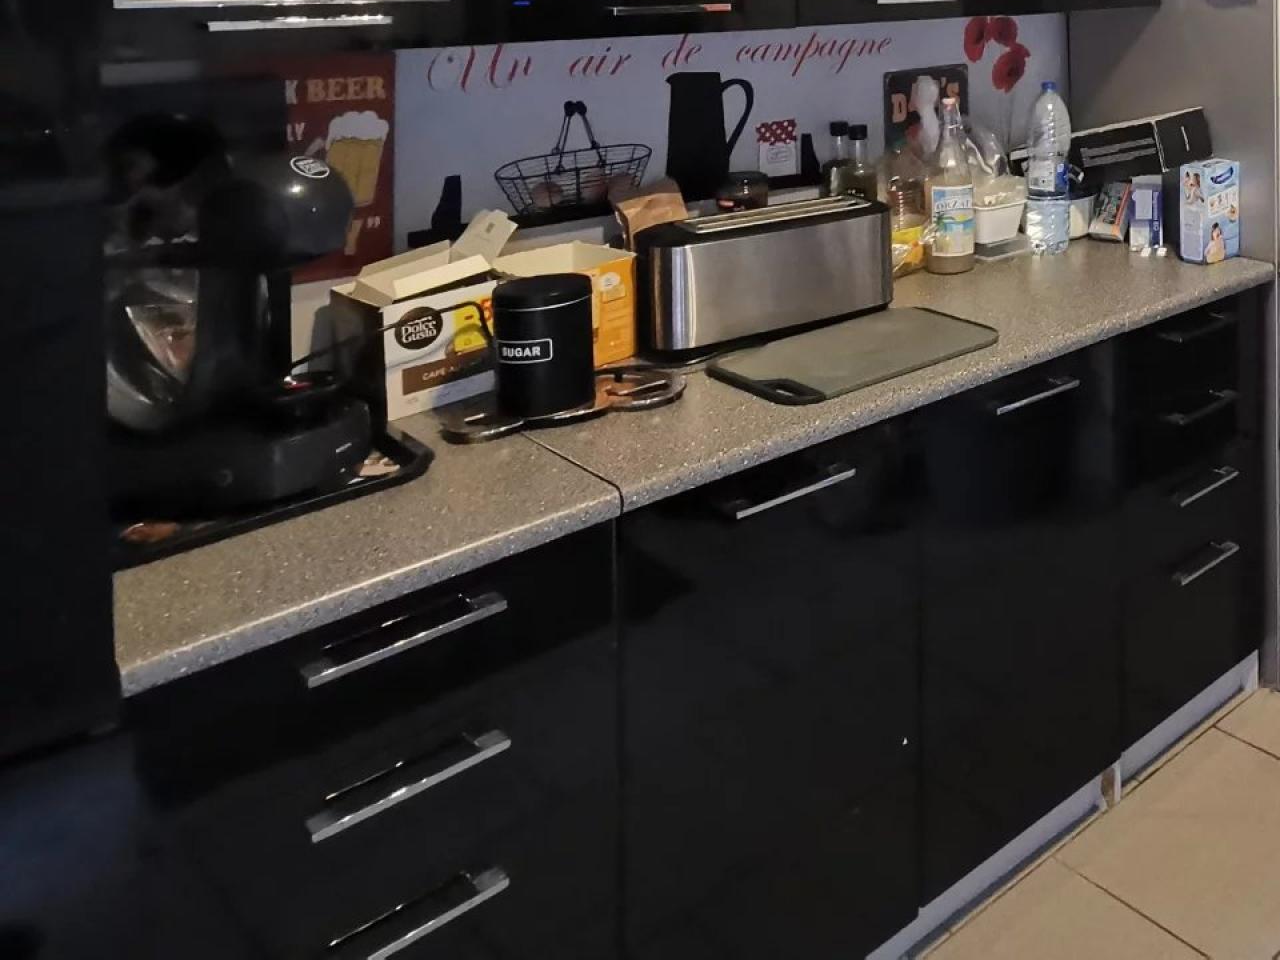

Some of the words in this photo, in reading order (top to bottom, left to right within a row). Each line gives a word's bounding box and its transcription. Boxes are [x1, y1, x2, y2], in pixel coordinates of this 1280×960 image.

[570, 46, 632, 76] air
[661, 33, 702, 70] de
[735, 32, 893, 77] campagne
[306, 75, 387, 103] BEER
[401, 318, 437, 336] Dolce
[402, 329, 438, 344] Gusto
[502, 345, 541, 358] SUGAR
